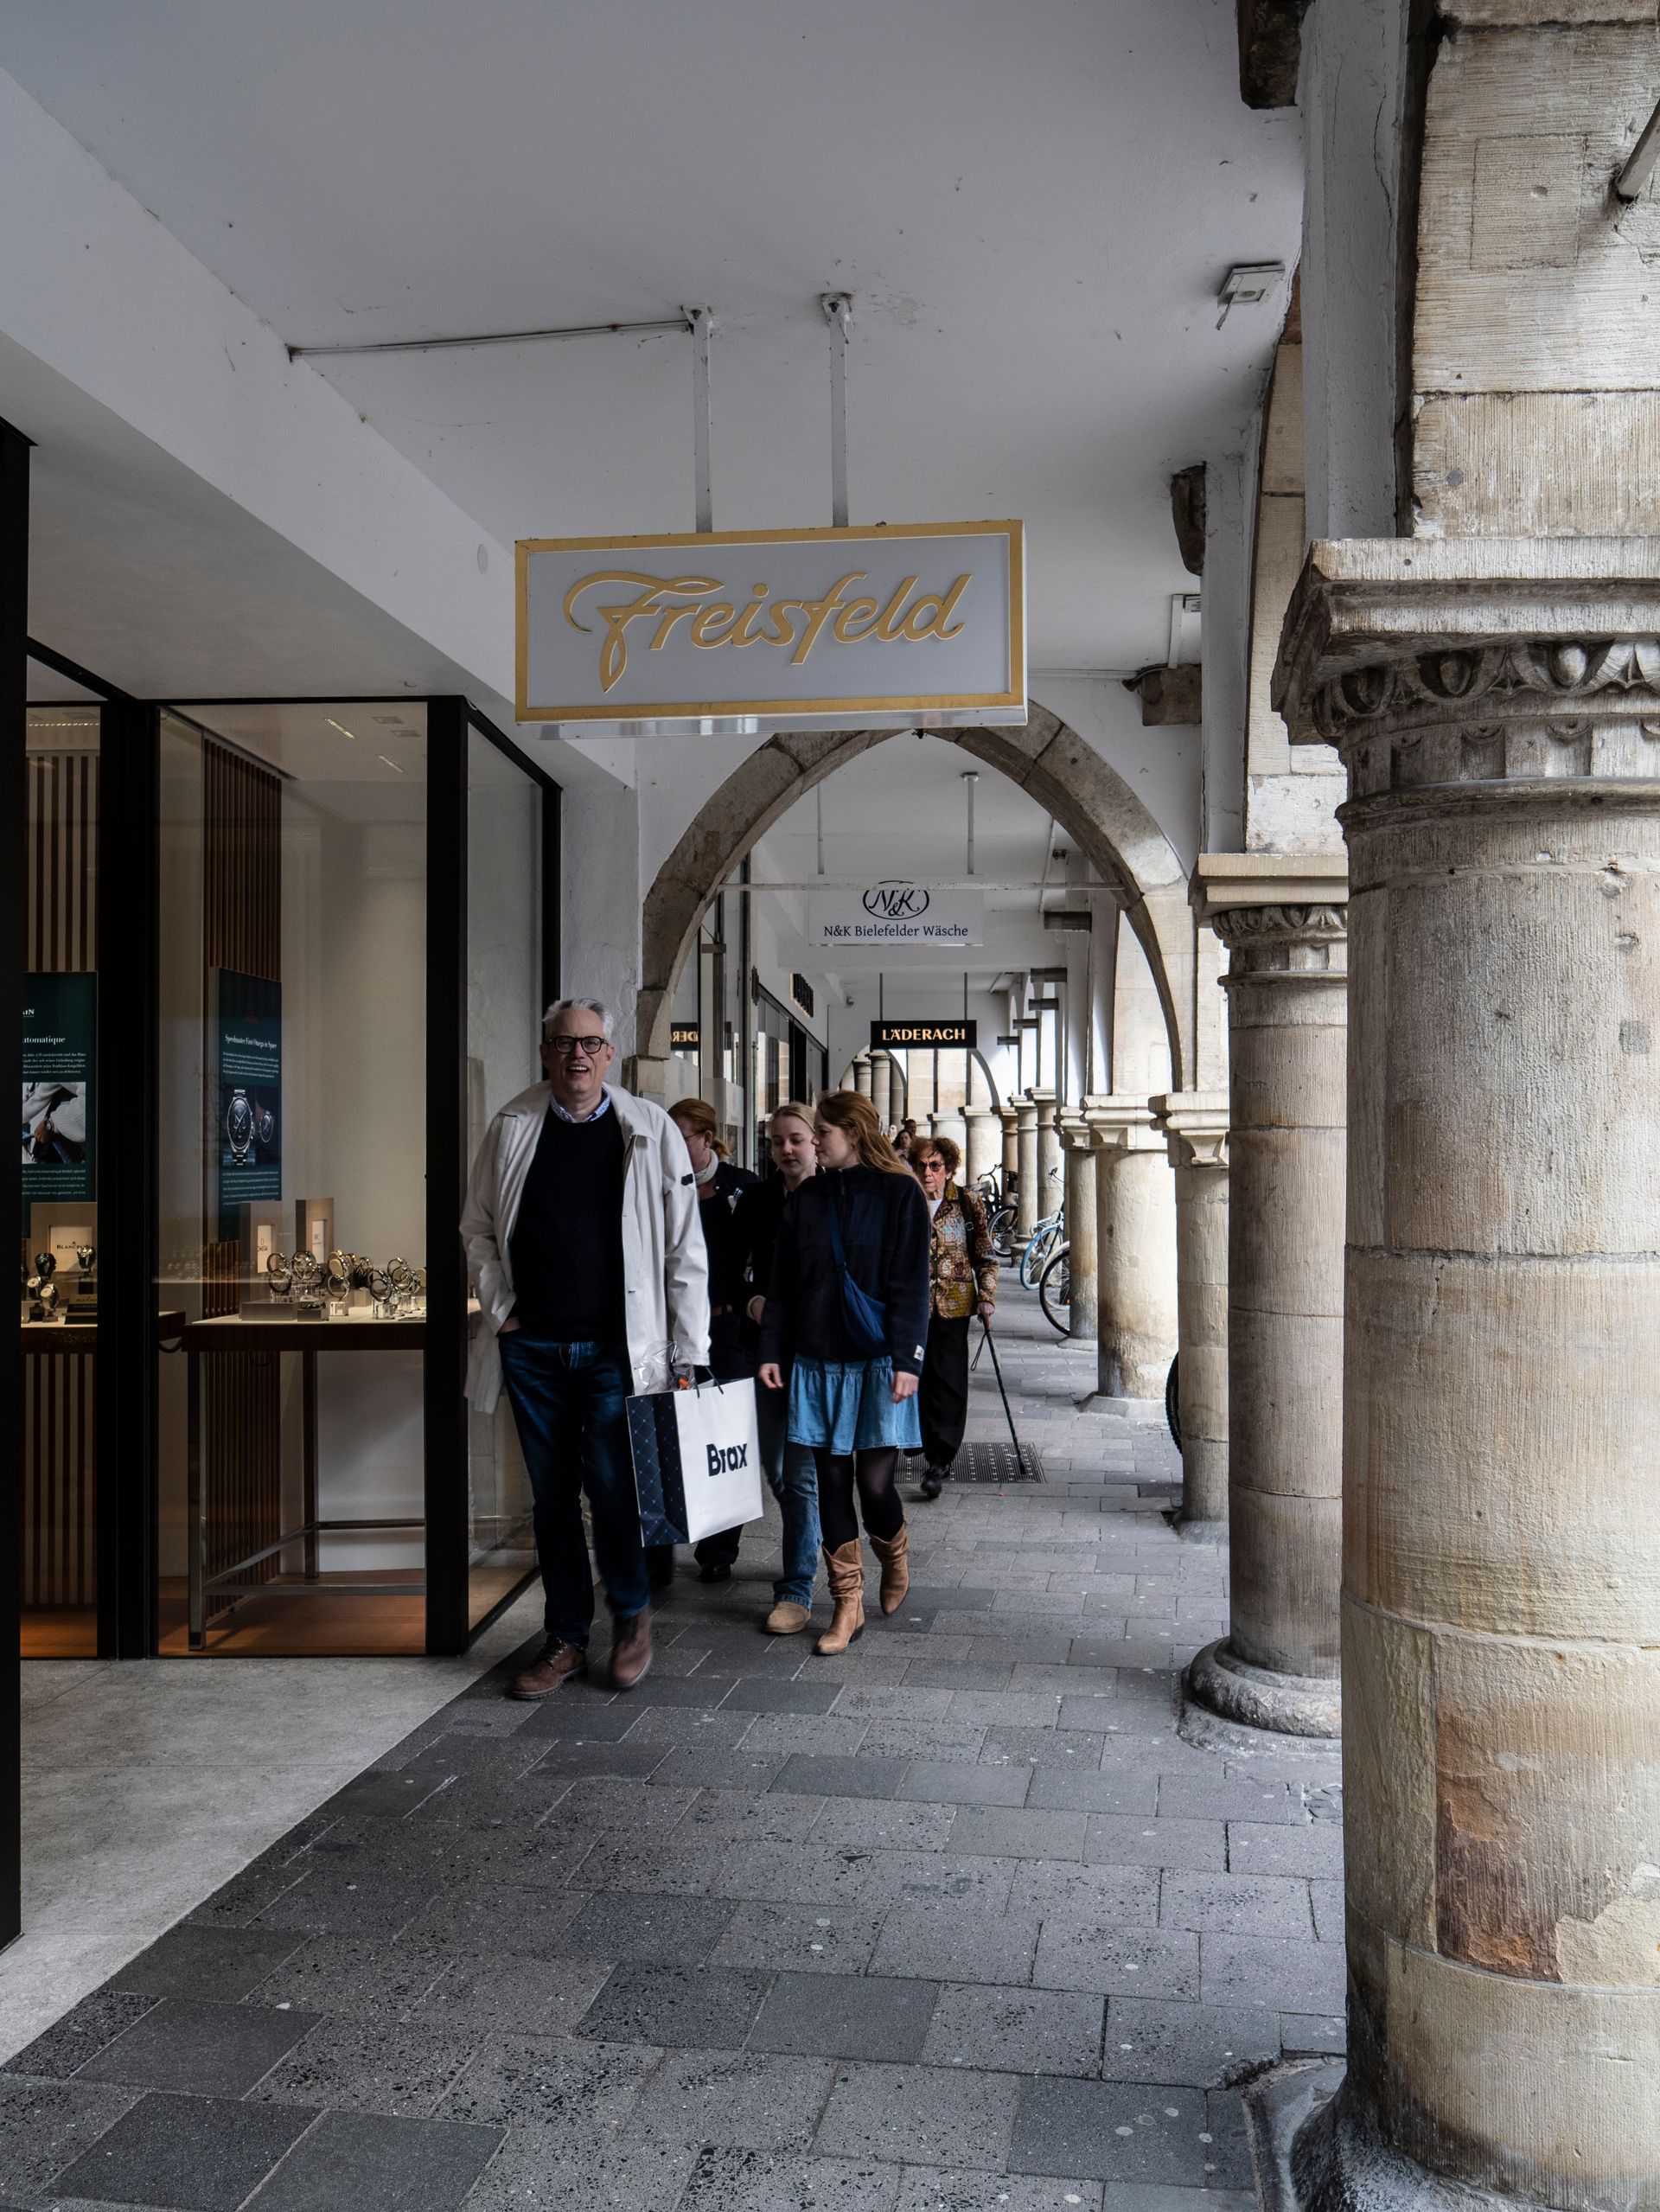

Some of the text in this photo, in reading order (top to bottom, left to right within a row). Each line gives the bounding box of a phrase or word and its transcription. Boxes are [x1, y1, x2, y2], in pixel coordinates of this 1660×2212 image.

[563, 571, 973, 694] Freisfeld
[824, 924, 968, 937] N&K Bielefelder Wäsche
[22, 1035, 66, 1045] utomatique
[882, 1028, 966, 1040] LÄDERACH
[706, 1442, 748, 1477] Brax
